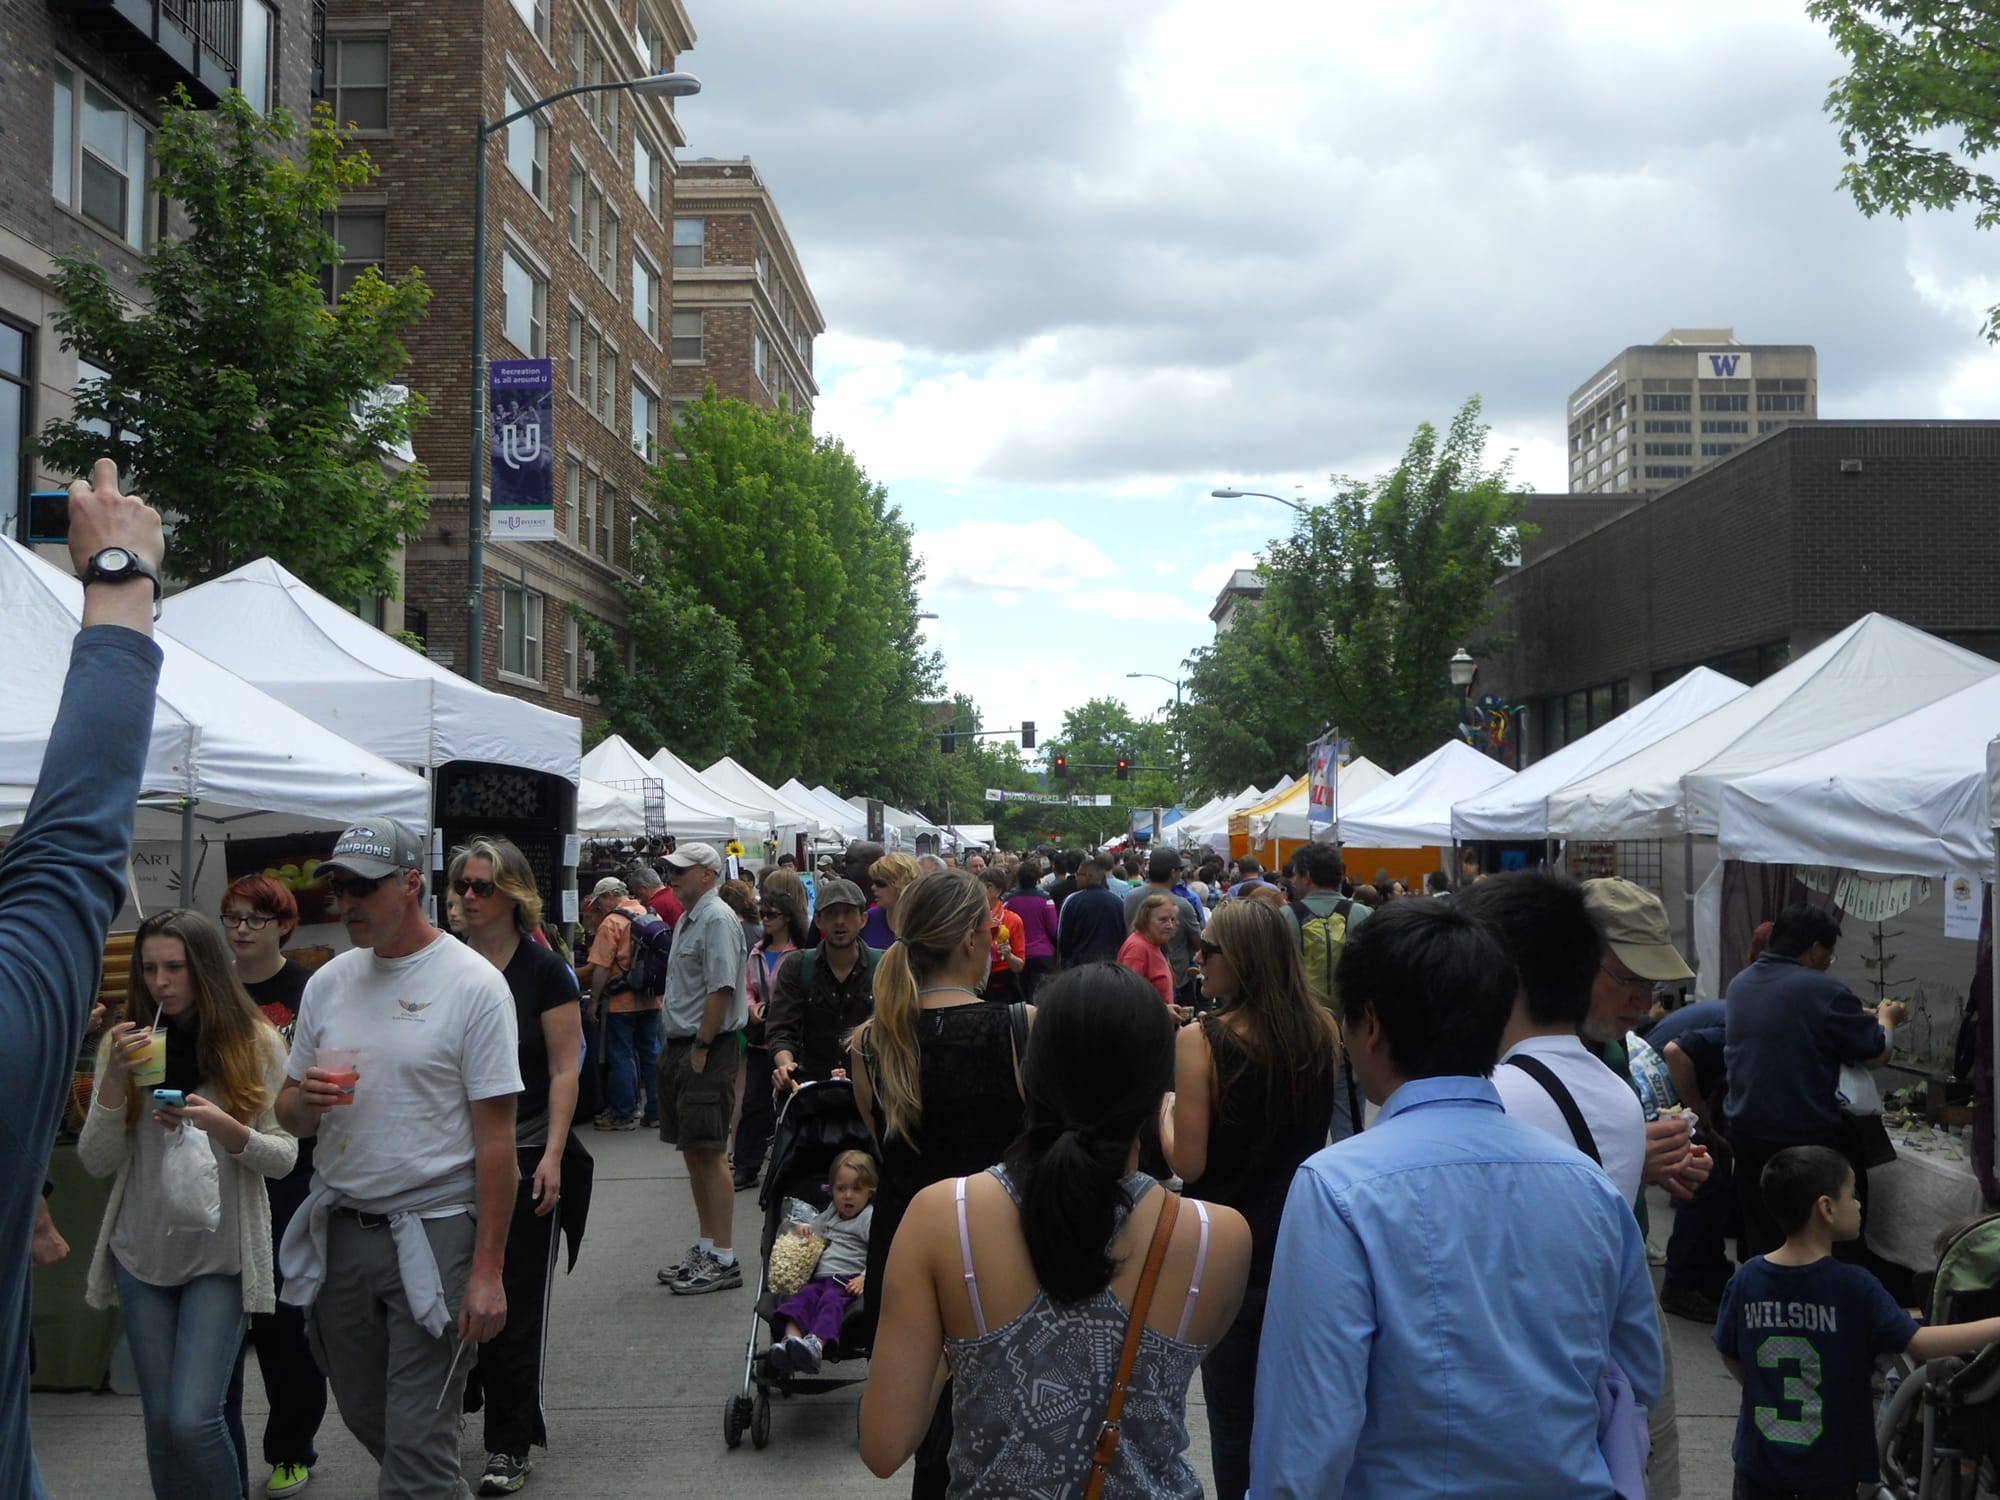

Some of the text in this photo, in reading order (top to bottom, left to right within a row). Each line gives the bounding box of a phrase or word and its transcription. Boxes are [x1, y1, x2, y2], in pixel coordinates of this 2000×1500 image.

[494, 375, 548, 384] is all around U
[501, 367, 541, 376] Recreation
[1709, 355, 1741, 377] W
[503, 423, 541, 470] U
[1744, 1301, 1838, 1333] WILSON
[1754, 1335, 1824, 1447] 3
